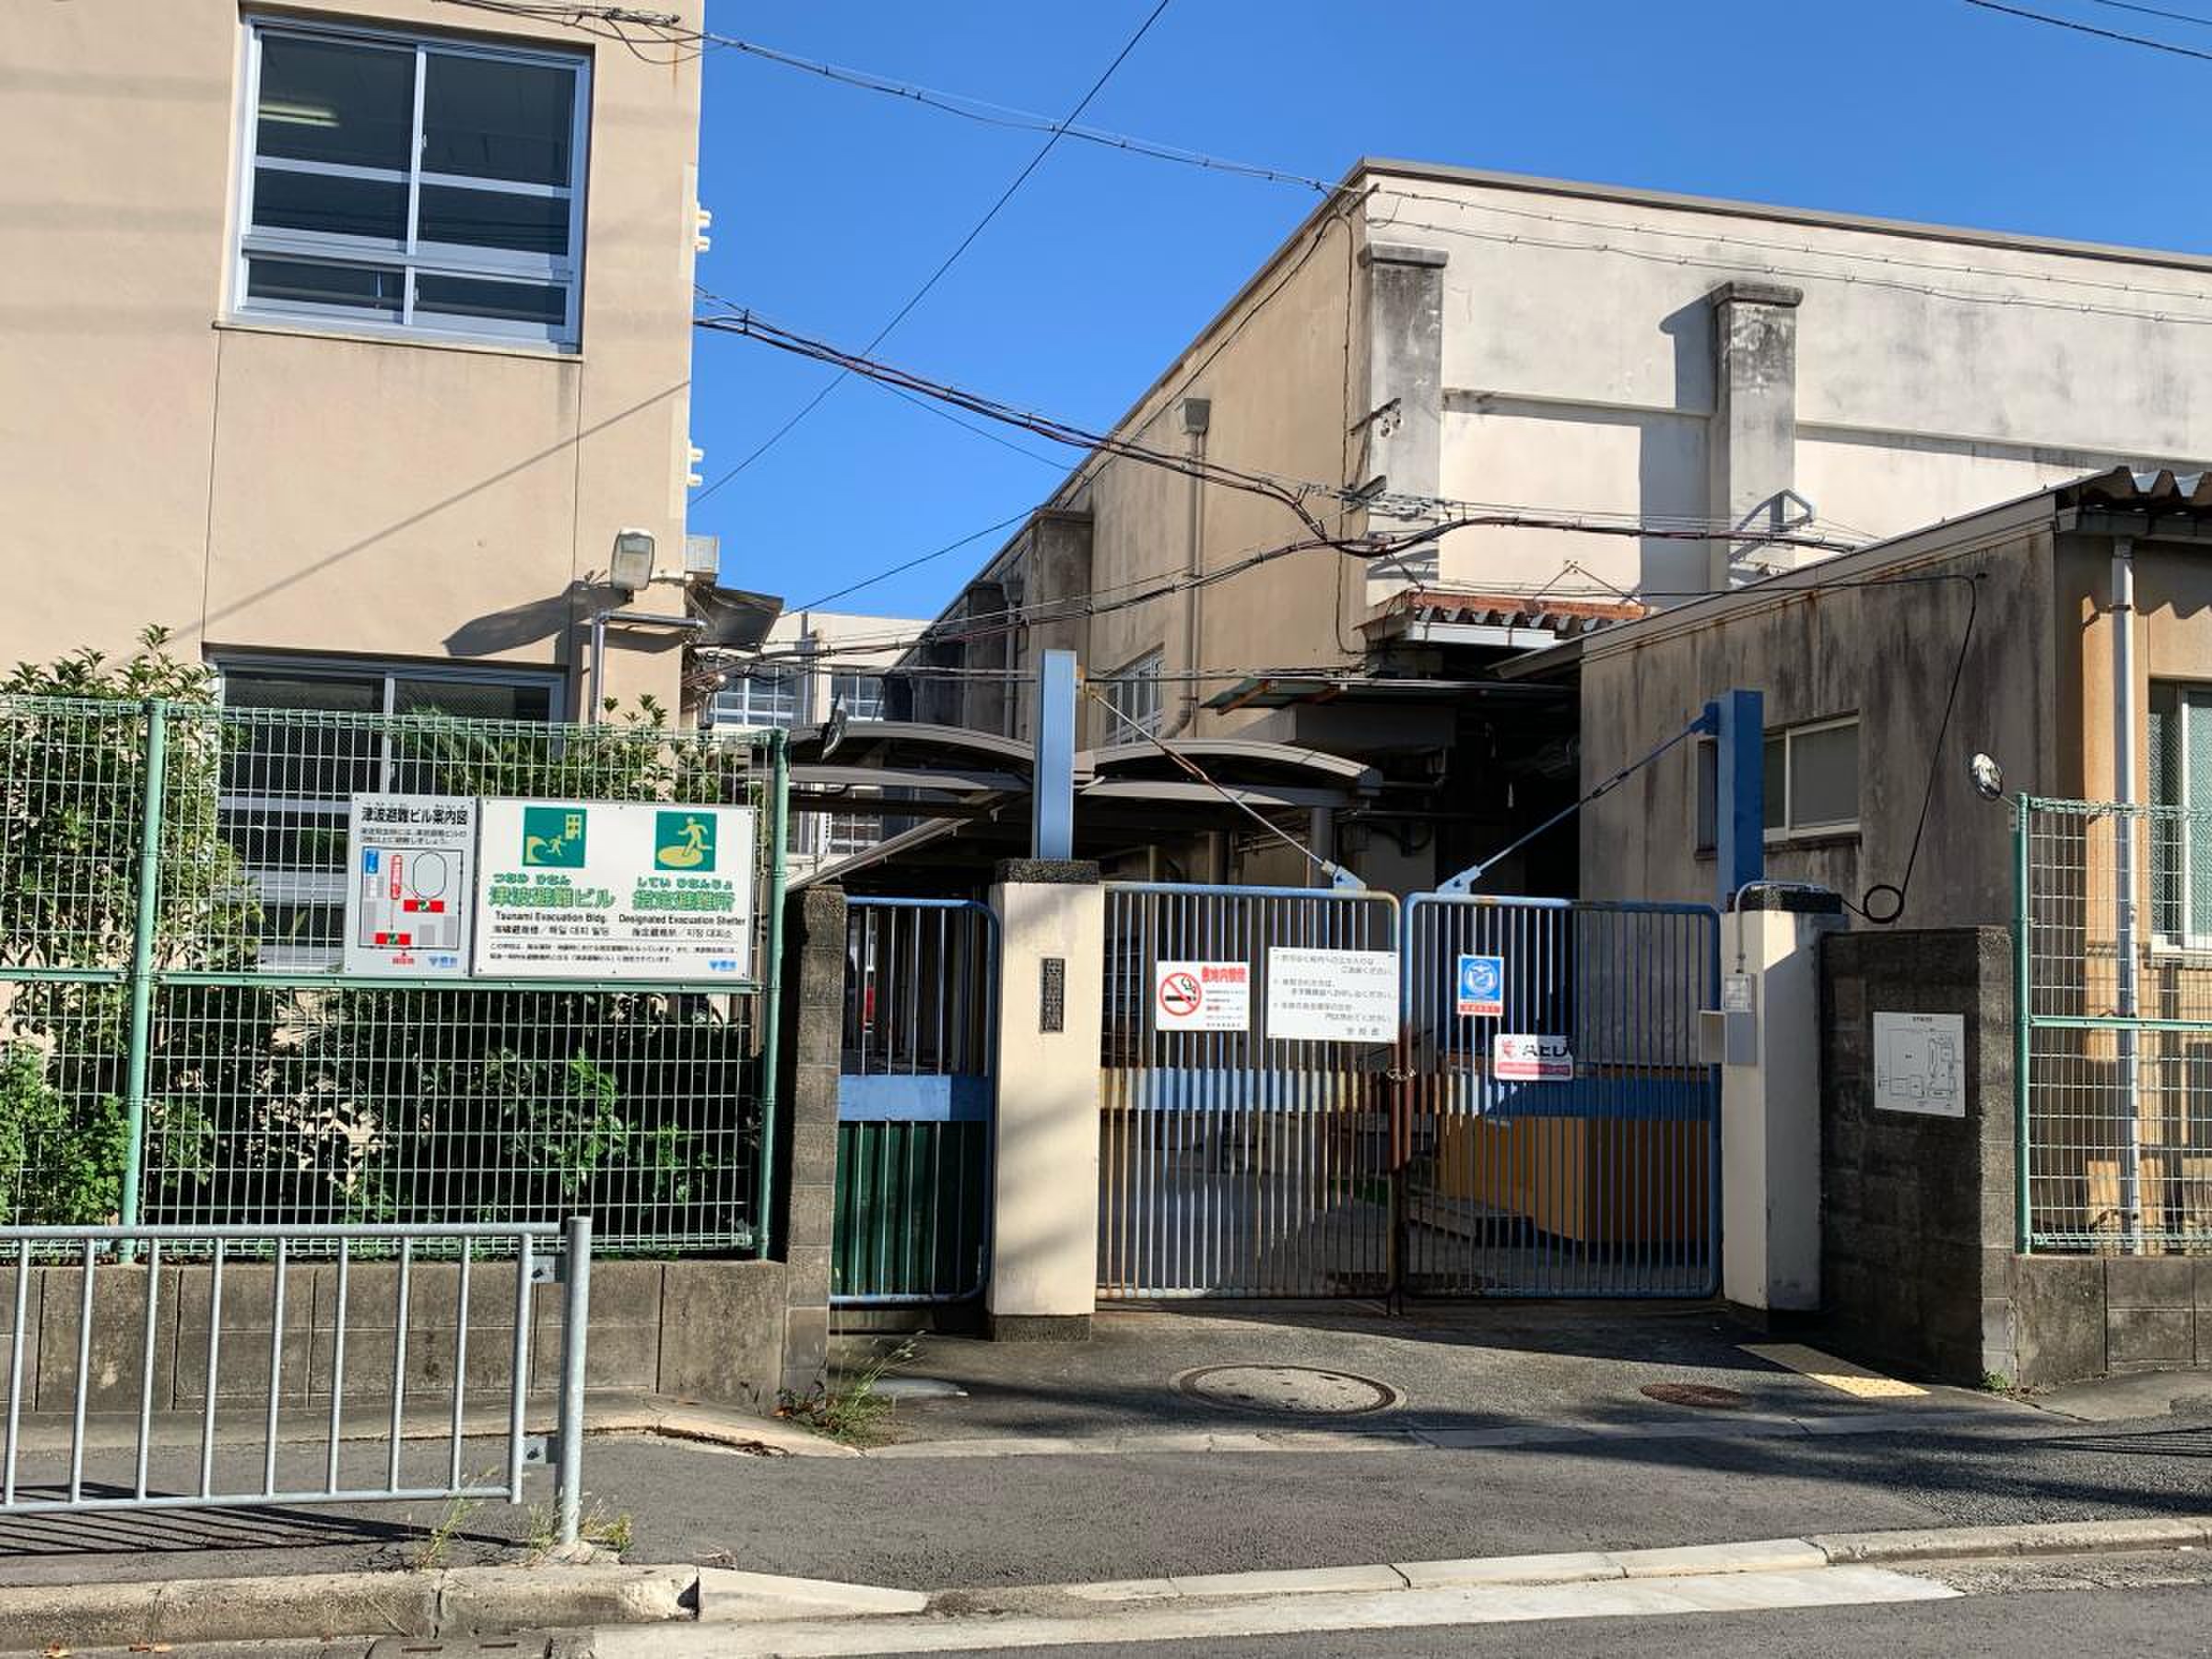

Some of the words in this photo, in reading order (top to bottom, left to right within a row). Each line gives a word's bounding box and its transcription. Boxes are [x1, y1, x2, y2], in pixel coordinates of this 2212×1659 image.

[361, 806, 468, 826] 津波避難ビル案内図
[488, 886, 617, 909] 津波避難ビル
[631, 889, 735, 912] 指定避難所
[495, 910, 533, 921] Tsunami
[535, 912, 583, 922] Evacuation
[618, 913, 665, 925] Designated
[667, 914, 715, 924] Evacuation
[716, 915, 746, 926] Shelter
